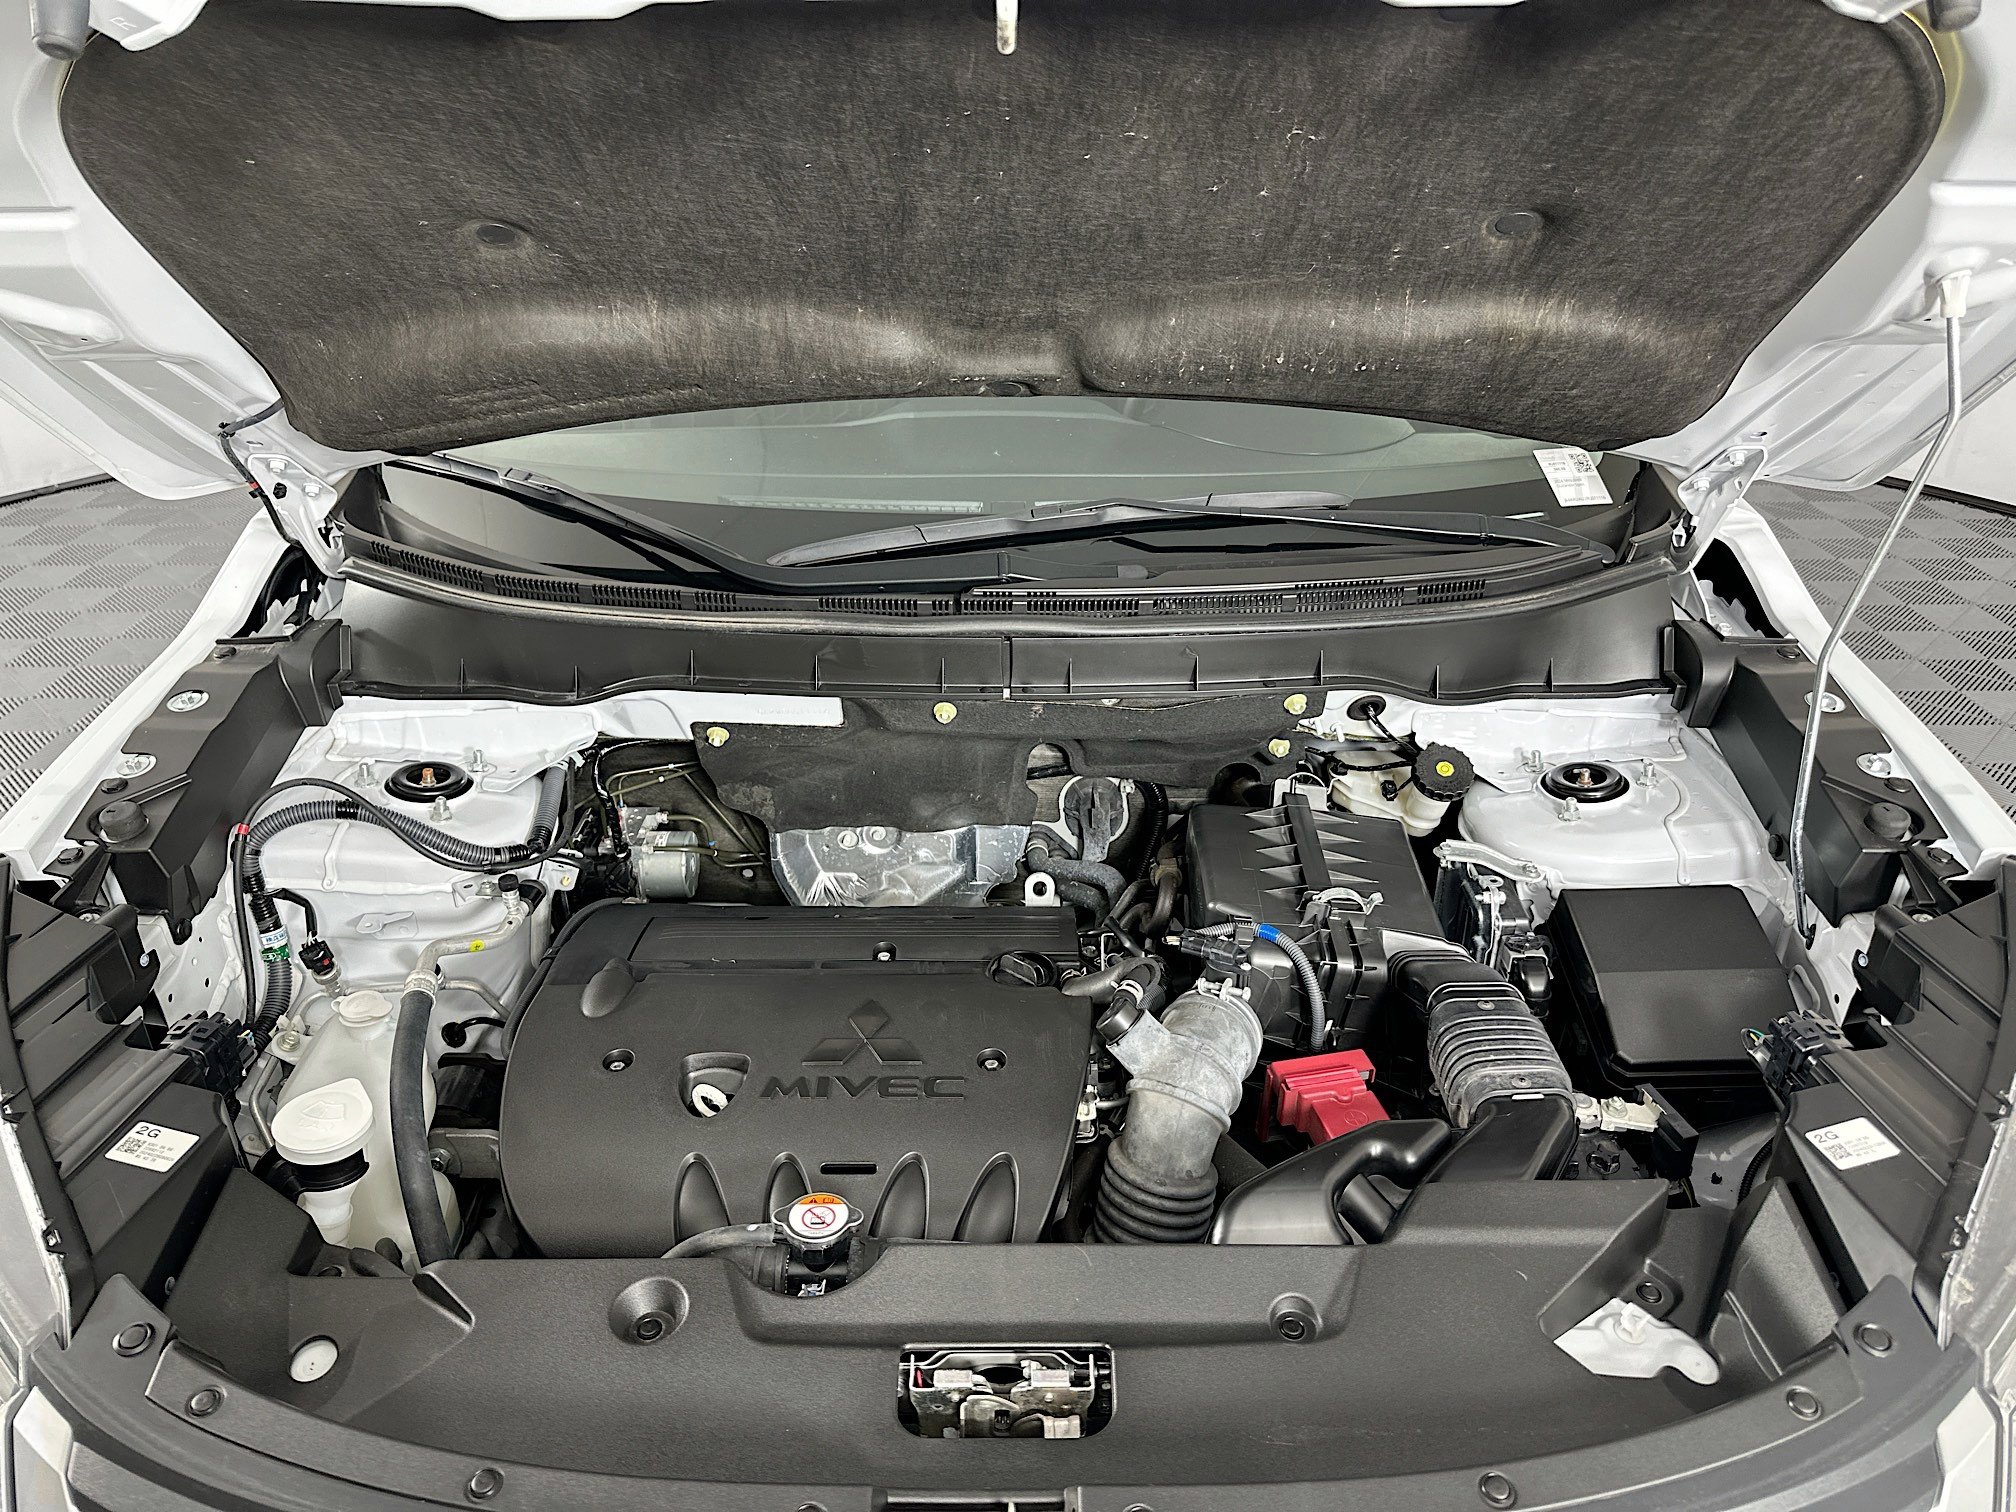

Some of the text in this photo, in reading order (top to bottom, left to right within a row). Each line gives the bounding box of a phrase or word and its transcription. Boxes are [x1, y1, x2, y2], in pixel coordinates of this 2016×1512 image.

[759, 1075, 965, 1100] MIVEC
[135, 1125, 162, 1139] 2G
[1813, 1130, 1840, 1144] 2G
